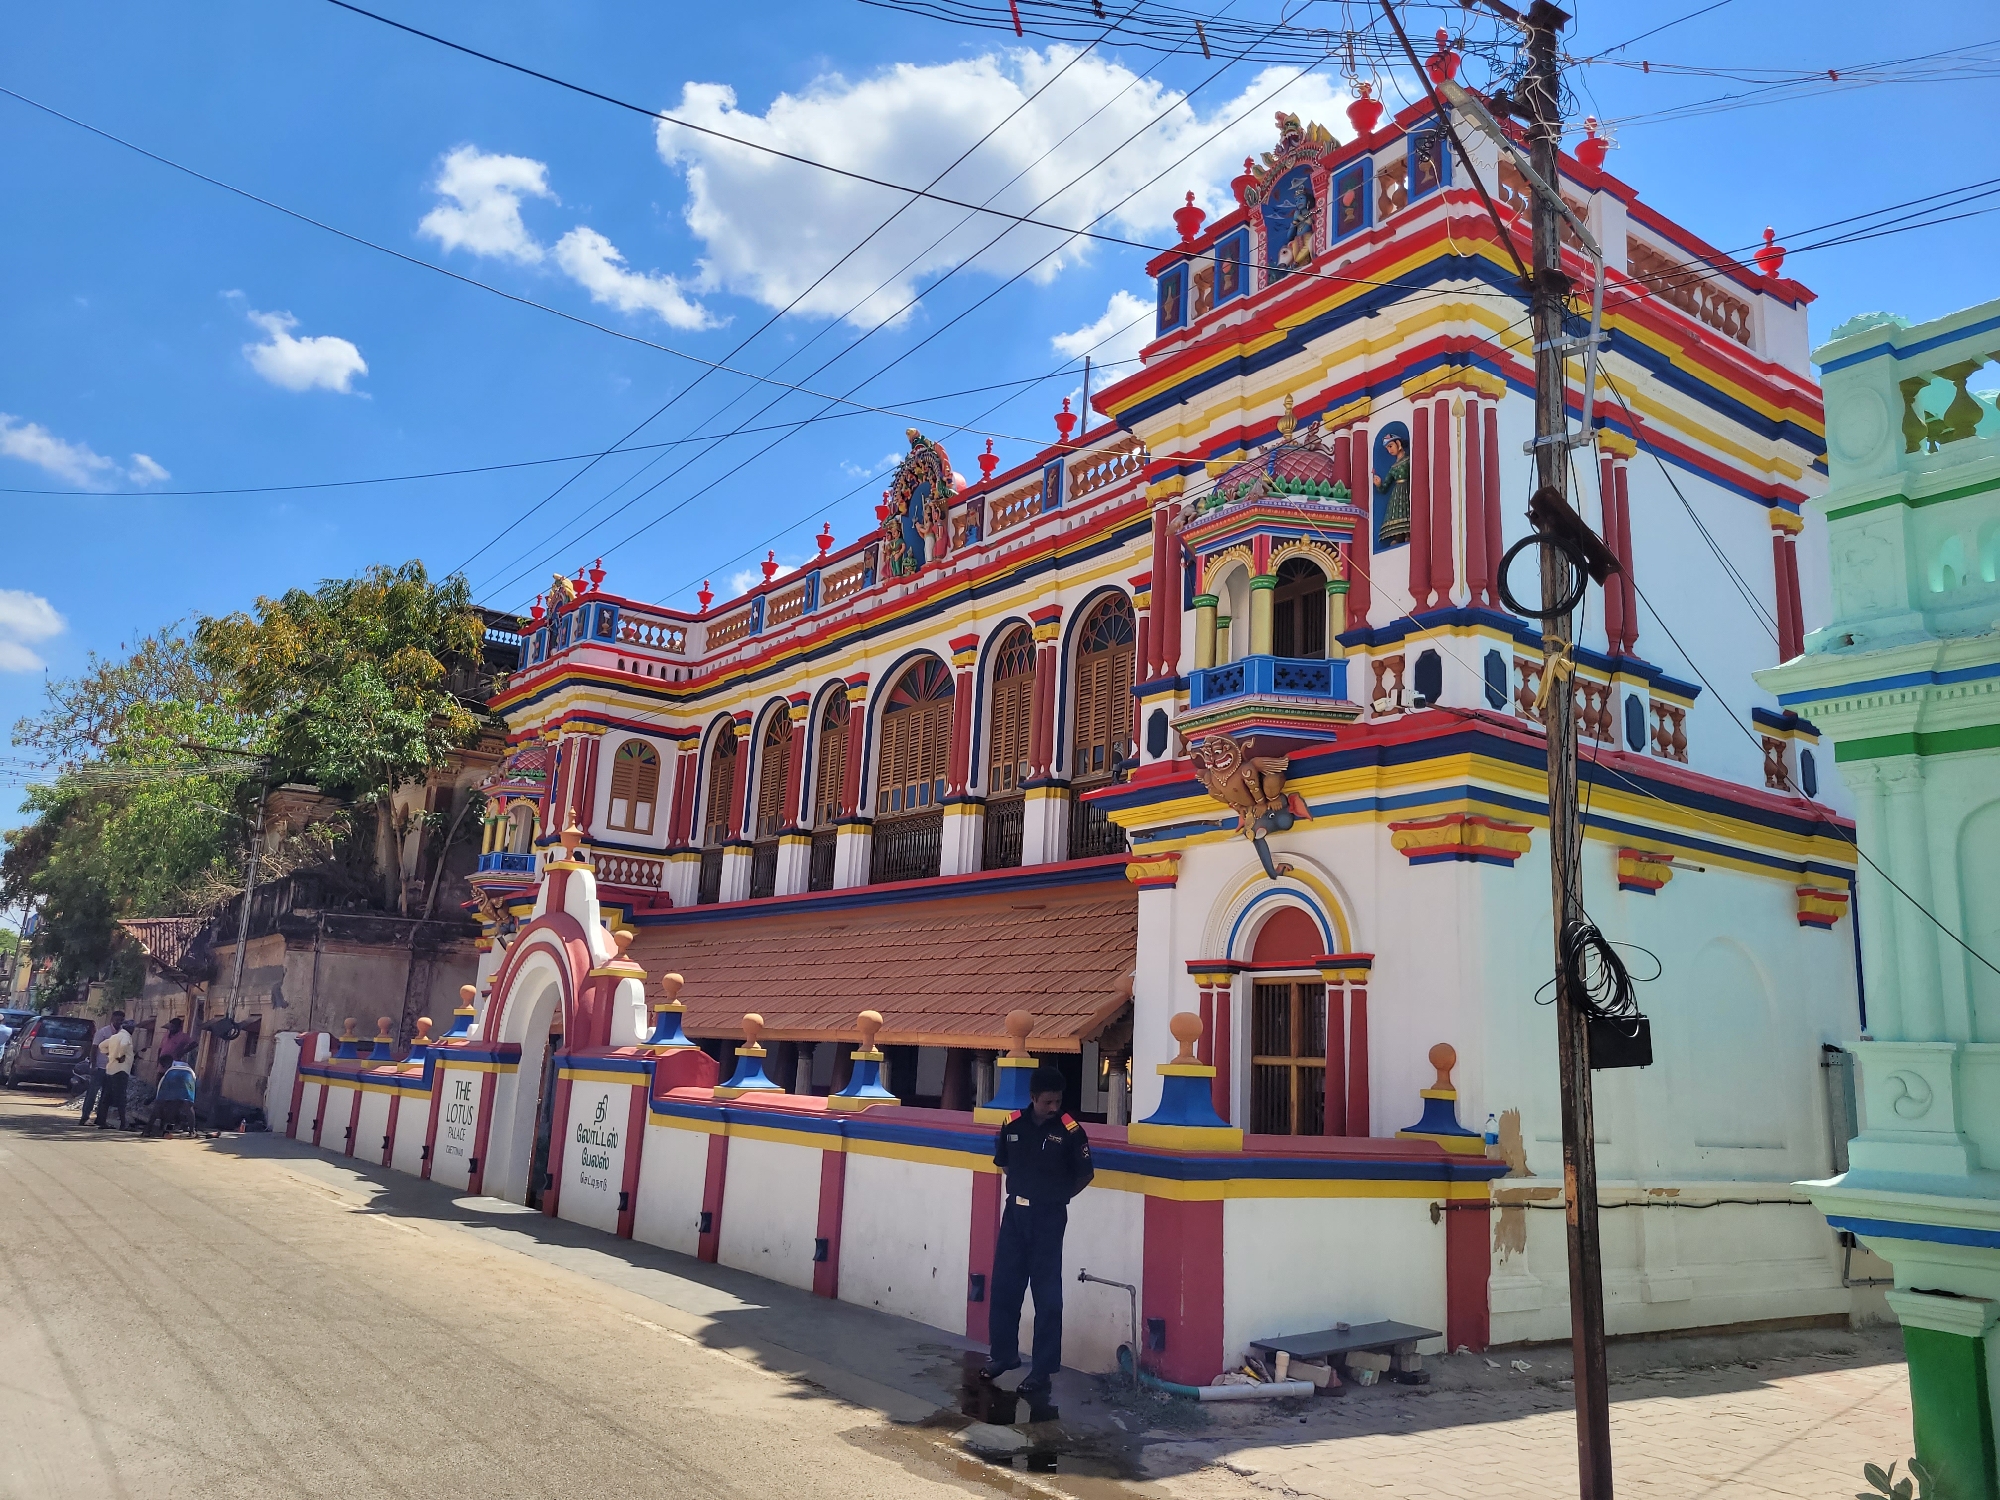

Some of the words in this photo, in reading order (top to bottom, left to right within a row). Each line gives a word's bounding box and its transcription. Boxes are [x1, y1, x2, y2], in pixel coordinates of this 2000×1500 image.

[455, 1080, 472, 1101] THE
[446, 1103, 474, 1126] LOTUS
[593, 1094, 609, 1126] தி
[447, 1126, 466, 1141] PALACE
[576, 1123, 619, 1149] லோட்டஸ்
[581, 1146, 610, 1170] பேலஸ்
